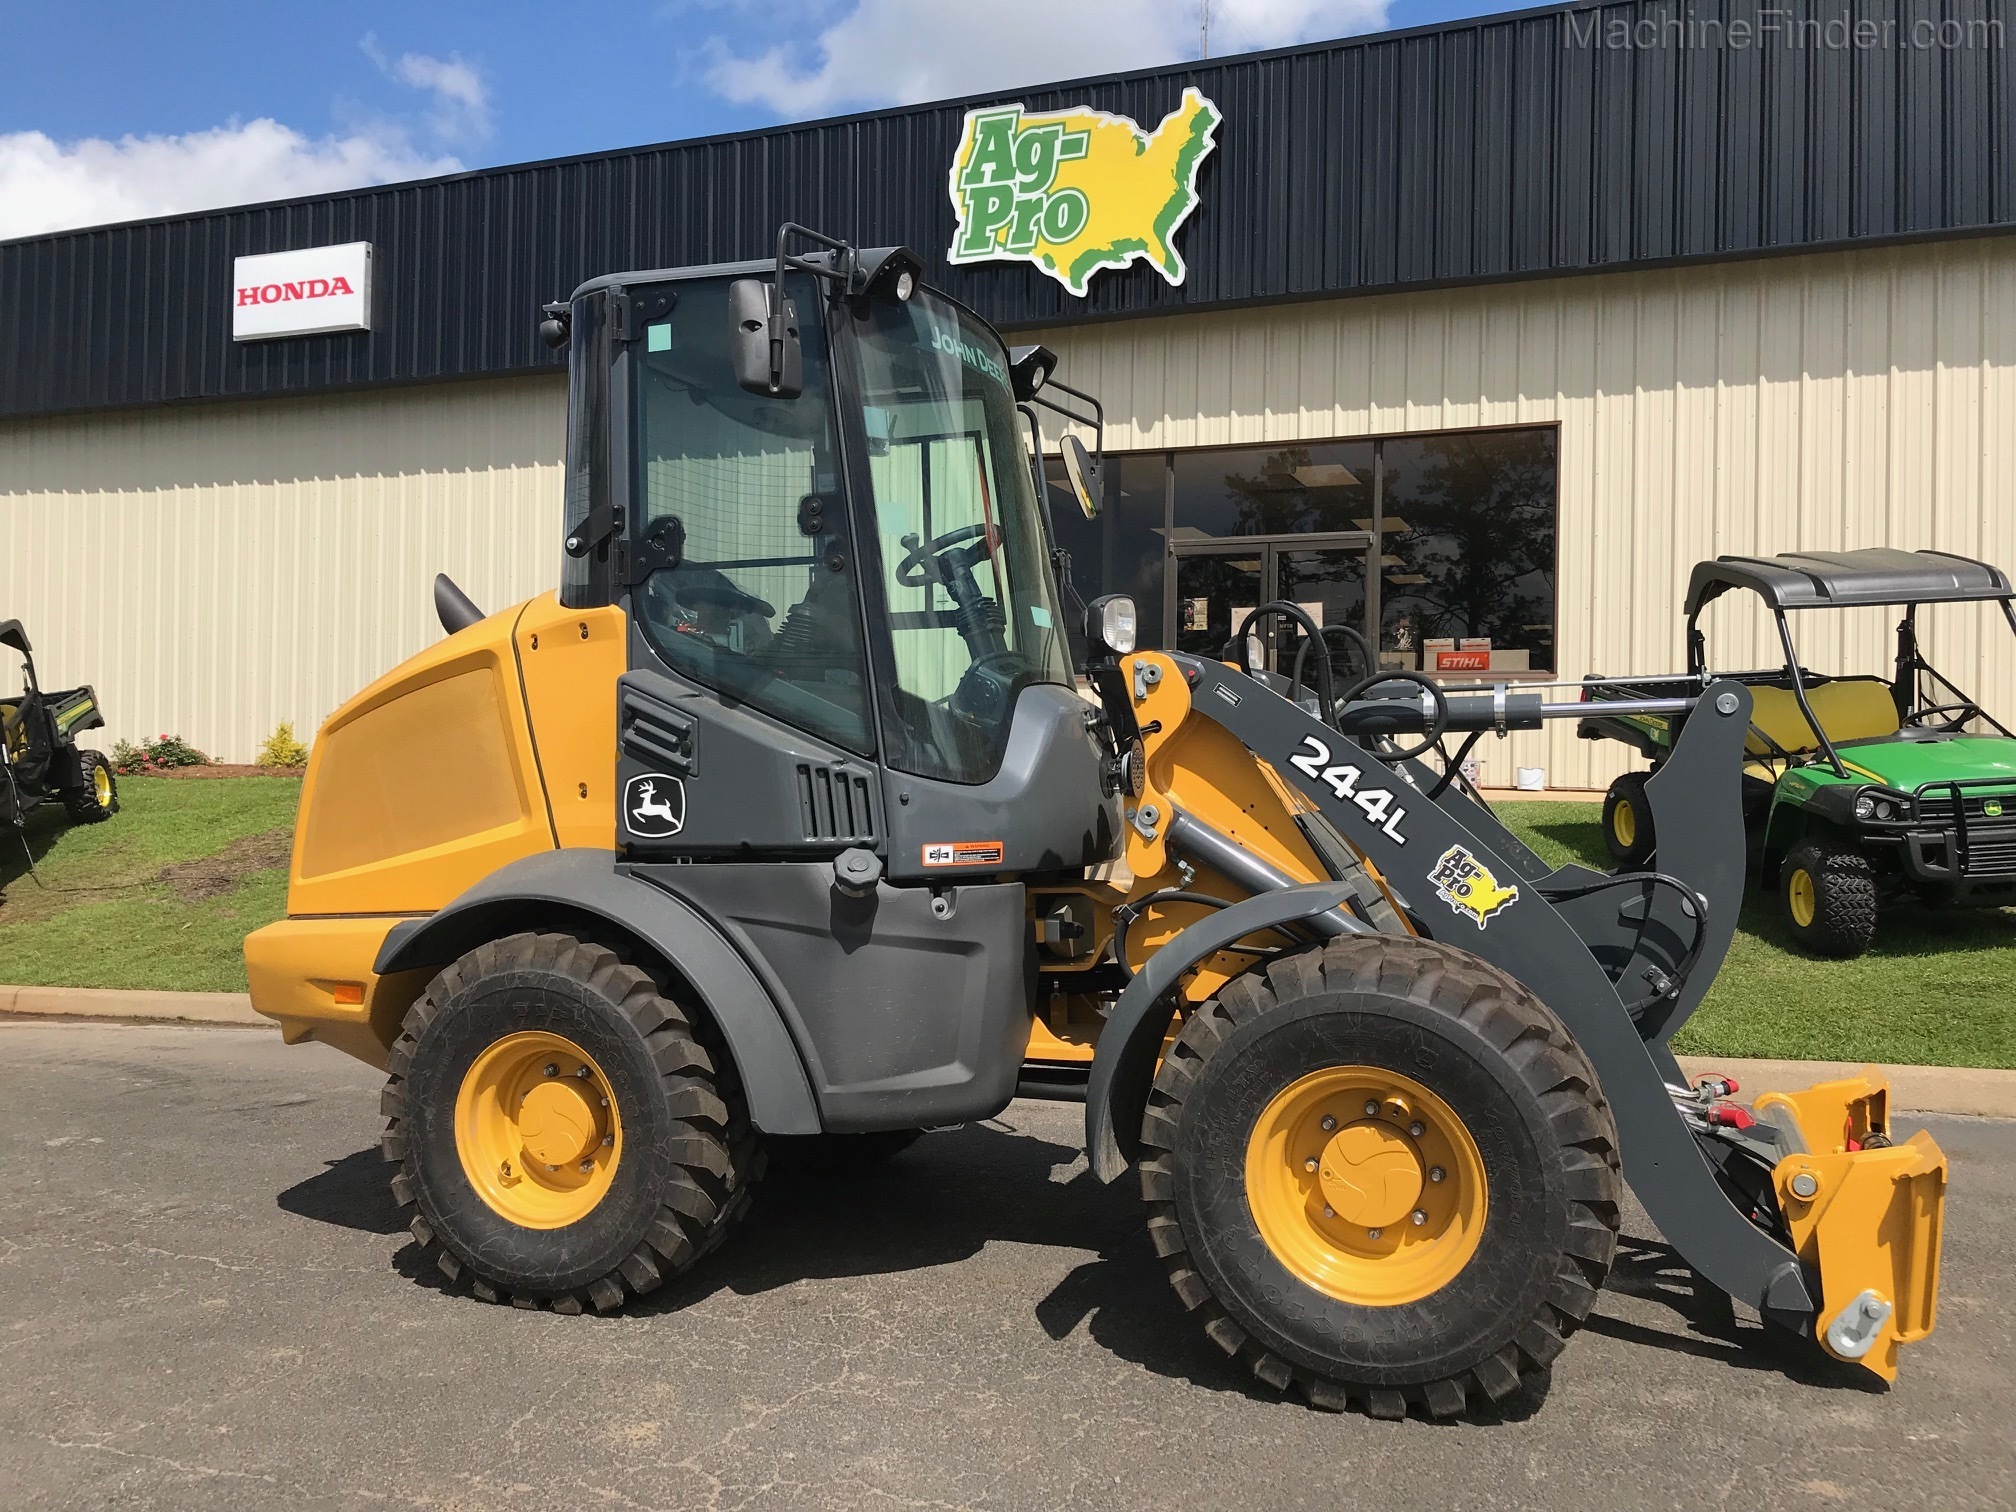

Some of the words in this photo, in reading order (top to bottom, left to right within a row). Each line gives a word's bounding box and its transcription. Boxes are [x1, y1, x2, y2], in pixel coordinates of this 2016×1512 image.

[959, 112, 1089, 195] Ag-
[957, 185, 1088, 255] Pro
[236, 276, 354, 306] HONDA
[931, 325, 977, 367] JOHN
[976, 347, 1011, 396] DEER
[1440, 657, 1483, 668] STIHL
[1287, 734, 1408, 847] 244L
[1431, 863, 1472, 898] Pro
[1443, 848, 1483, 879] Ag-
